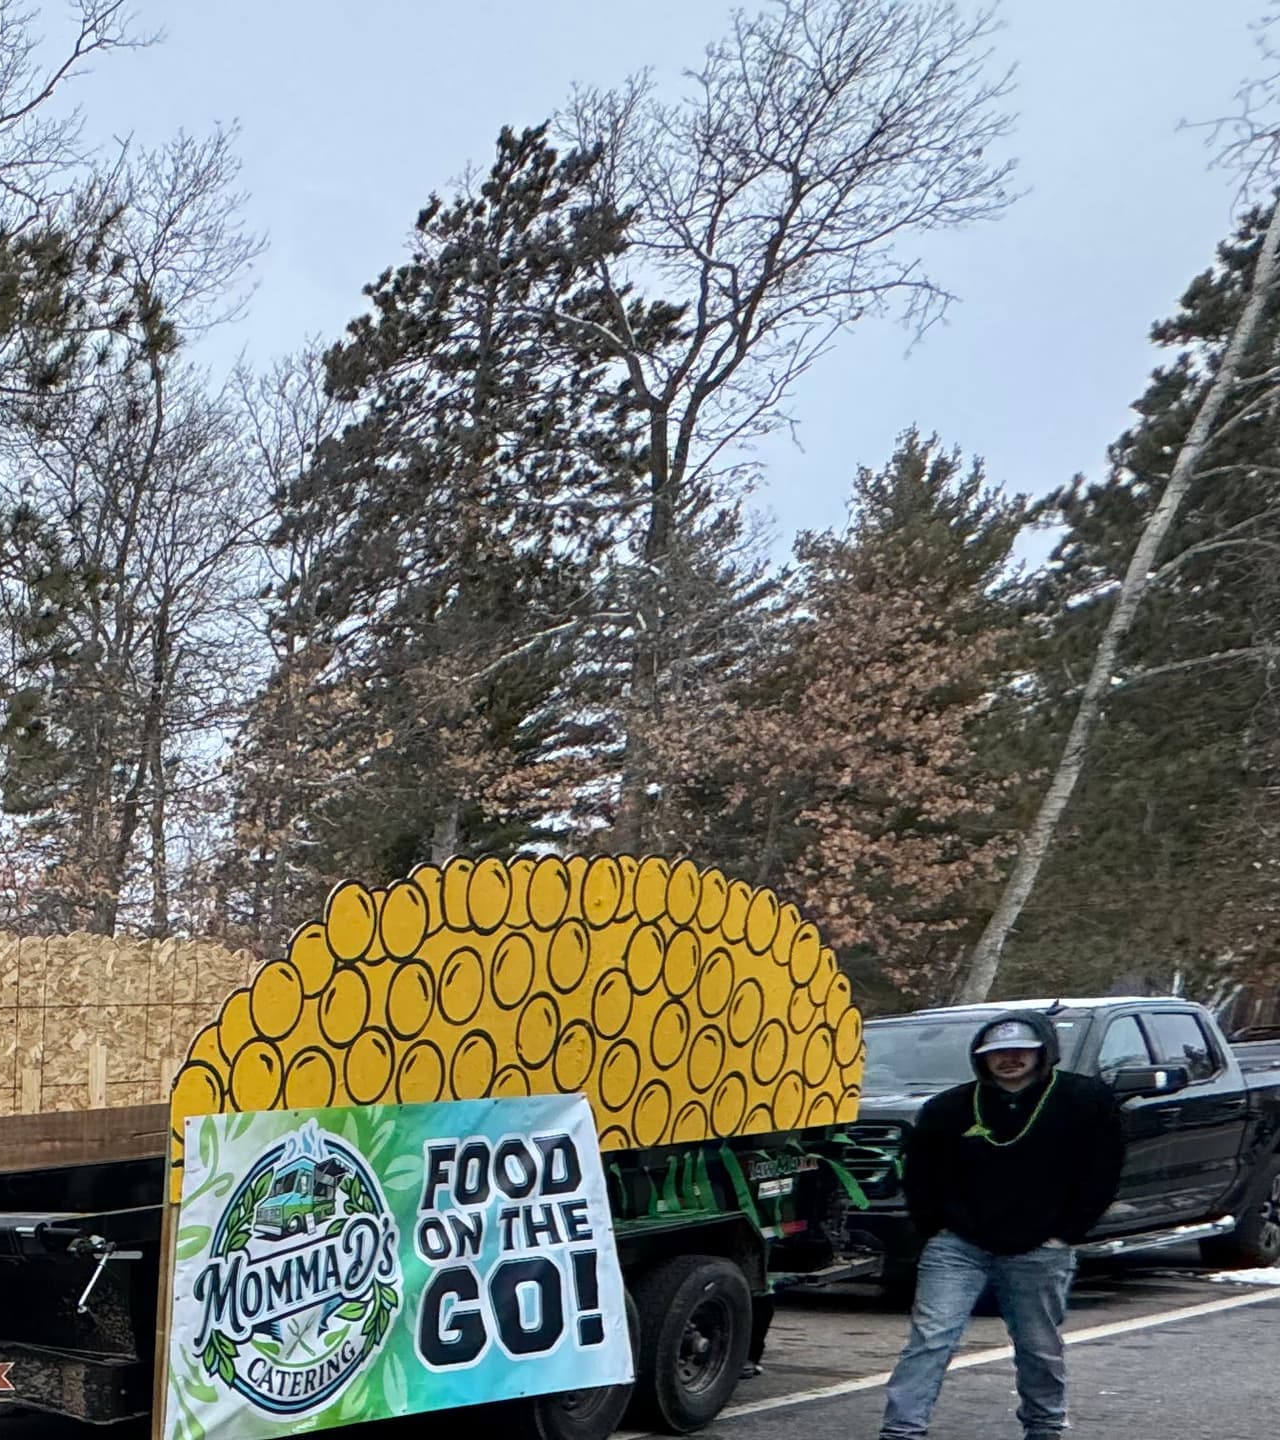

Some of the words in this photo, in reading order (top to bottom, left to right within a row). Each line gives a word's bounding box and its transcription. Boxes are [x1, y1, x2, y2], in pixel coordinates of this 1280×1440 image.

[420, 1133, 583, 1210] FOOD
[418, 1211, 484, 1261] ON
[499, 1198, 593, 1251] THE
[418, 1248, 605, 1367] GO!
[247, 1340, 357, 1397] CATERING
